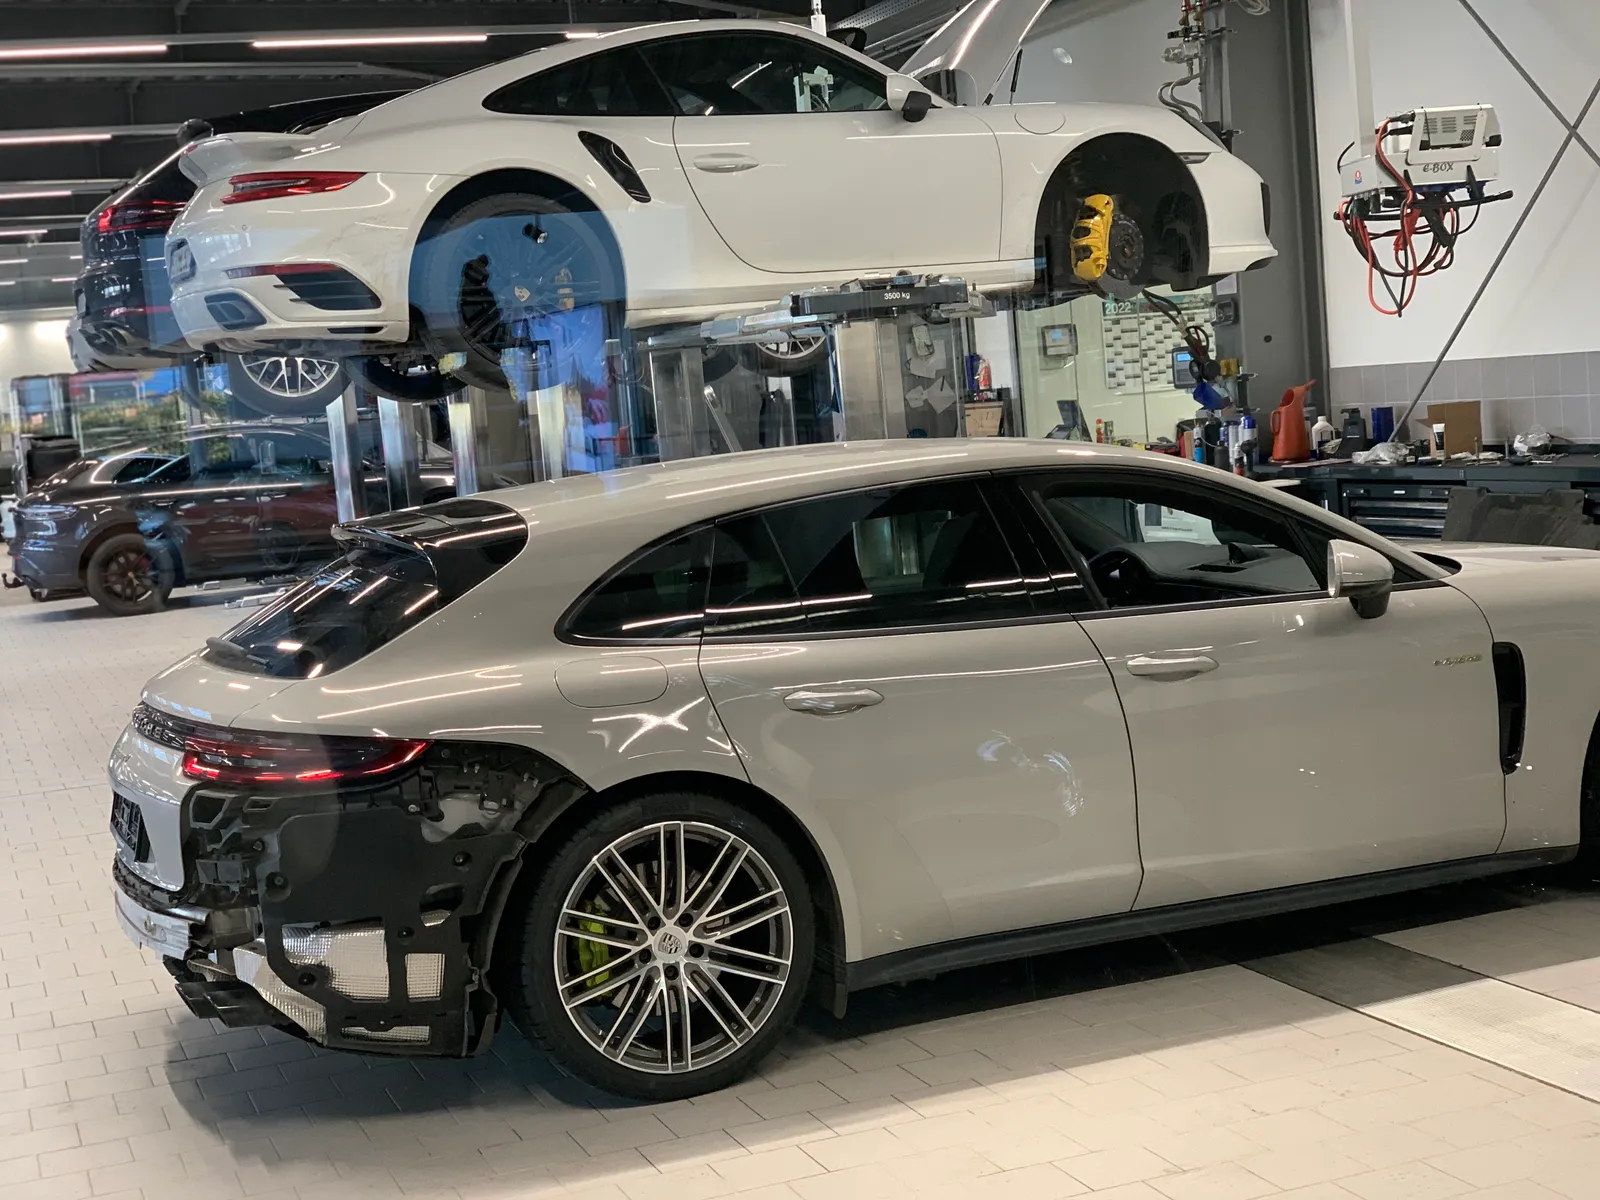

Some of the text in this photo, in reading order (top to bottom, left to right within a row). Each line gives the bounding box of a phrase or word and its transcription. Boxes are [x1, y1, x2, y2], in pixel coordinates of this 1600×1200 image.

[884, 291, 911, 300] 3500 kg
[1104, 302, 1131, 314] 2022
